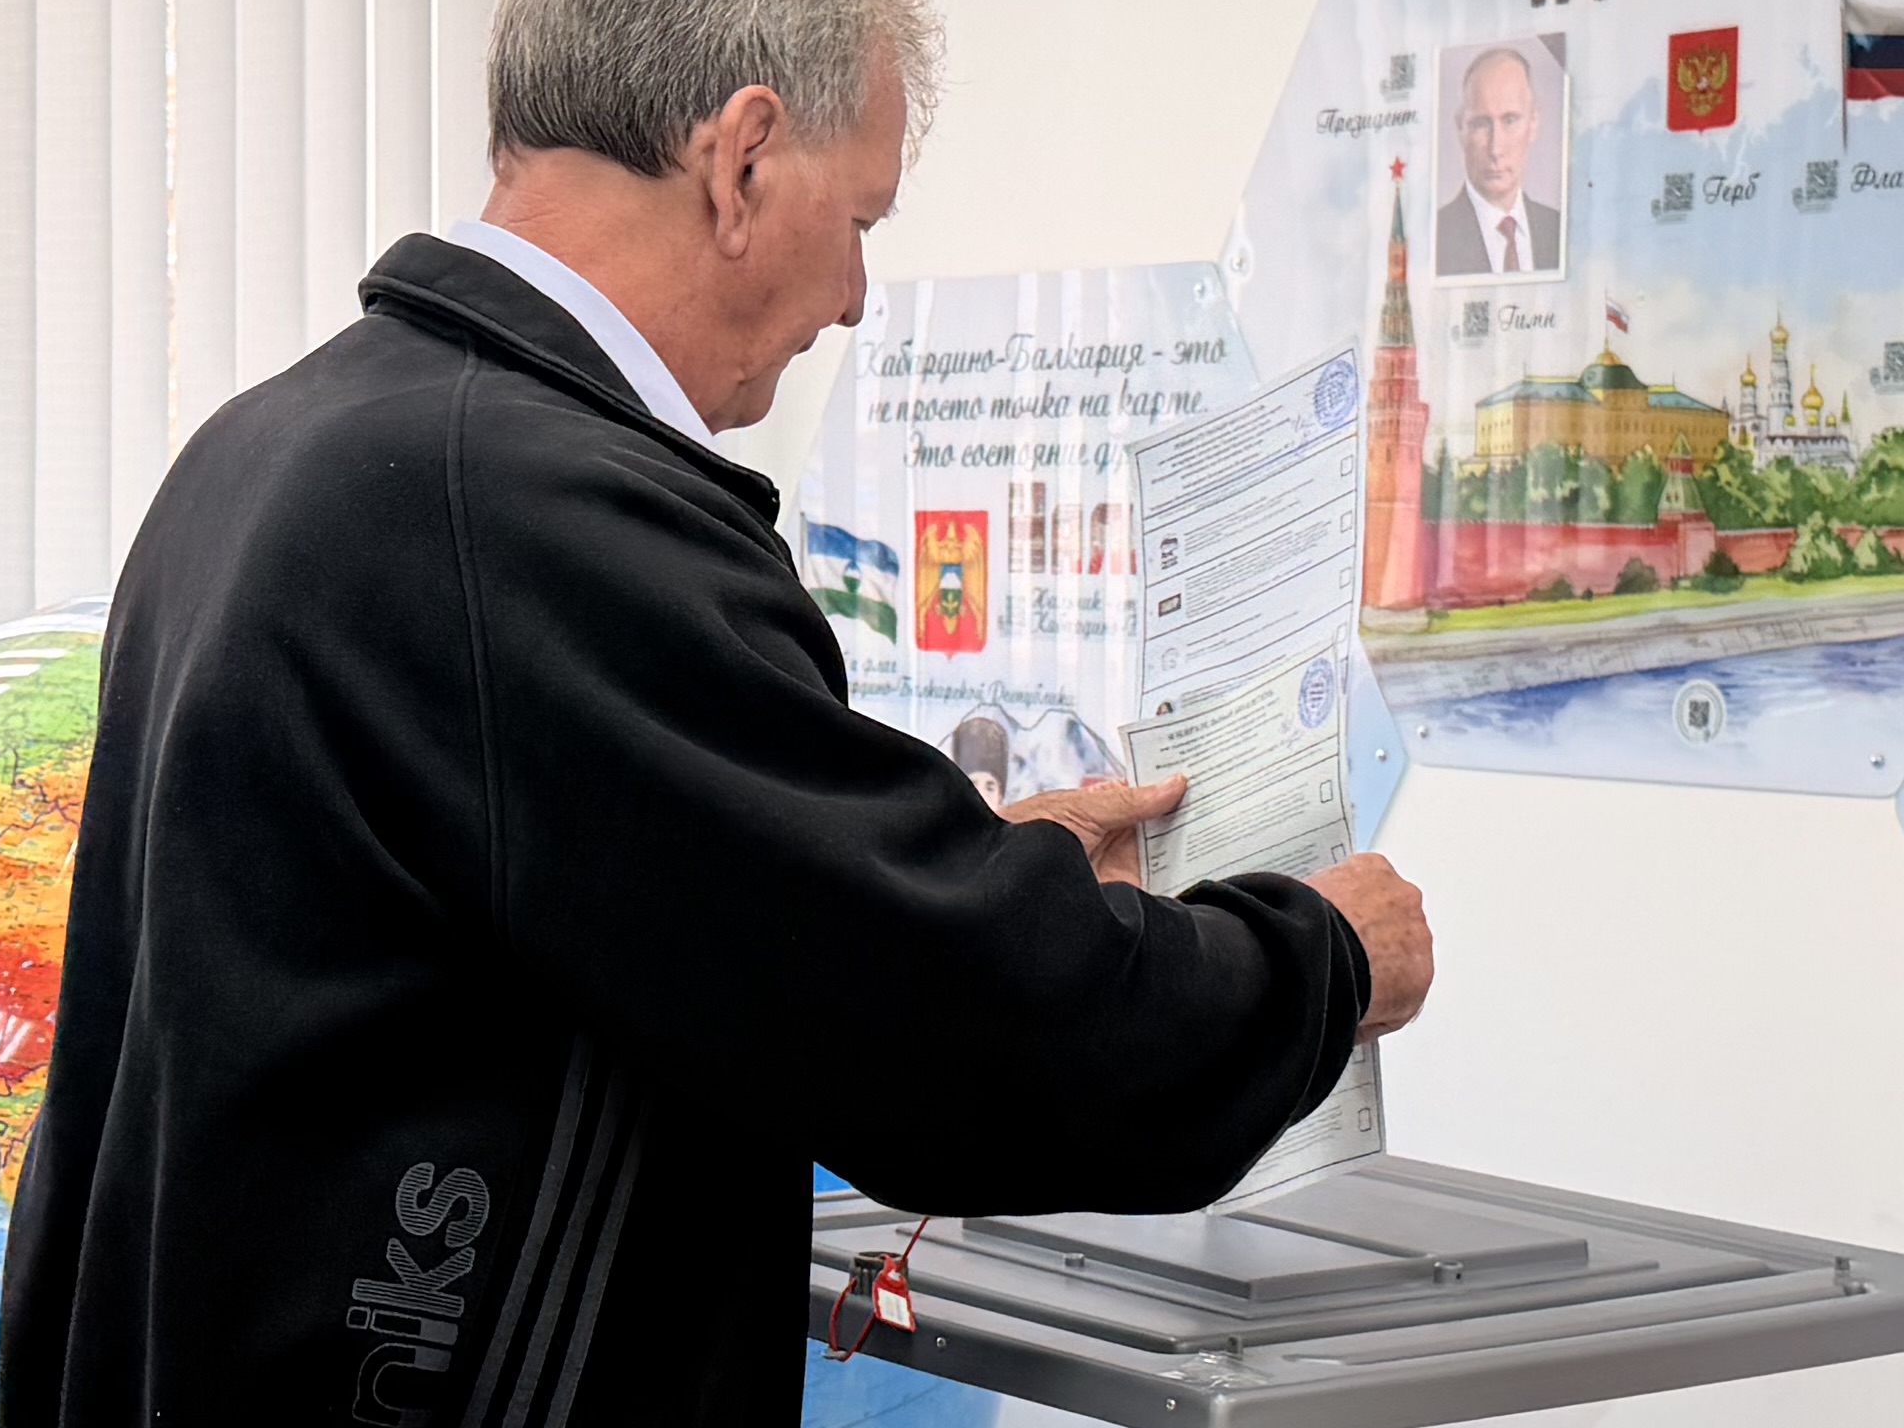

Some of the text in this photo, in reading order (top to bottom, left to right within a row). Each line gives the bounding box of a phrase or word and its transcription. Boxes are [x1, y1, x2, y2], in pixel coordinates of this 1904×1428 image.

[1316, 108, 1417, 139] Президент
[1703, 173, 1760, 206] Герб
[1498, 305, 1556, 331] Гимн
[1170, 337, 1227, 365] это
[990, 382, 1070, 421] точка
[1079, 393, 1111, 417] на
[903, 430, 955, 469] Это
